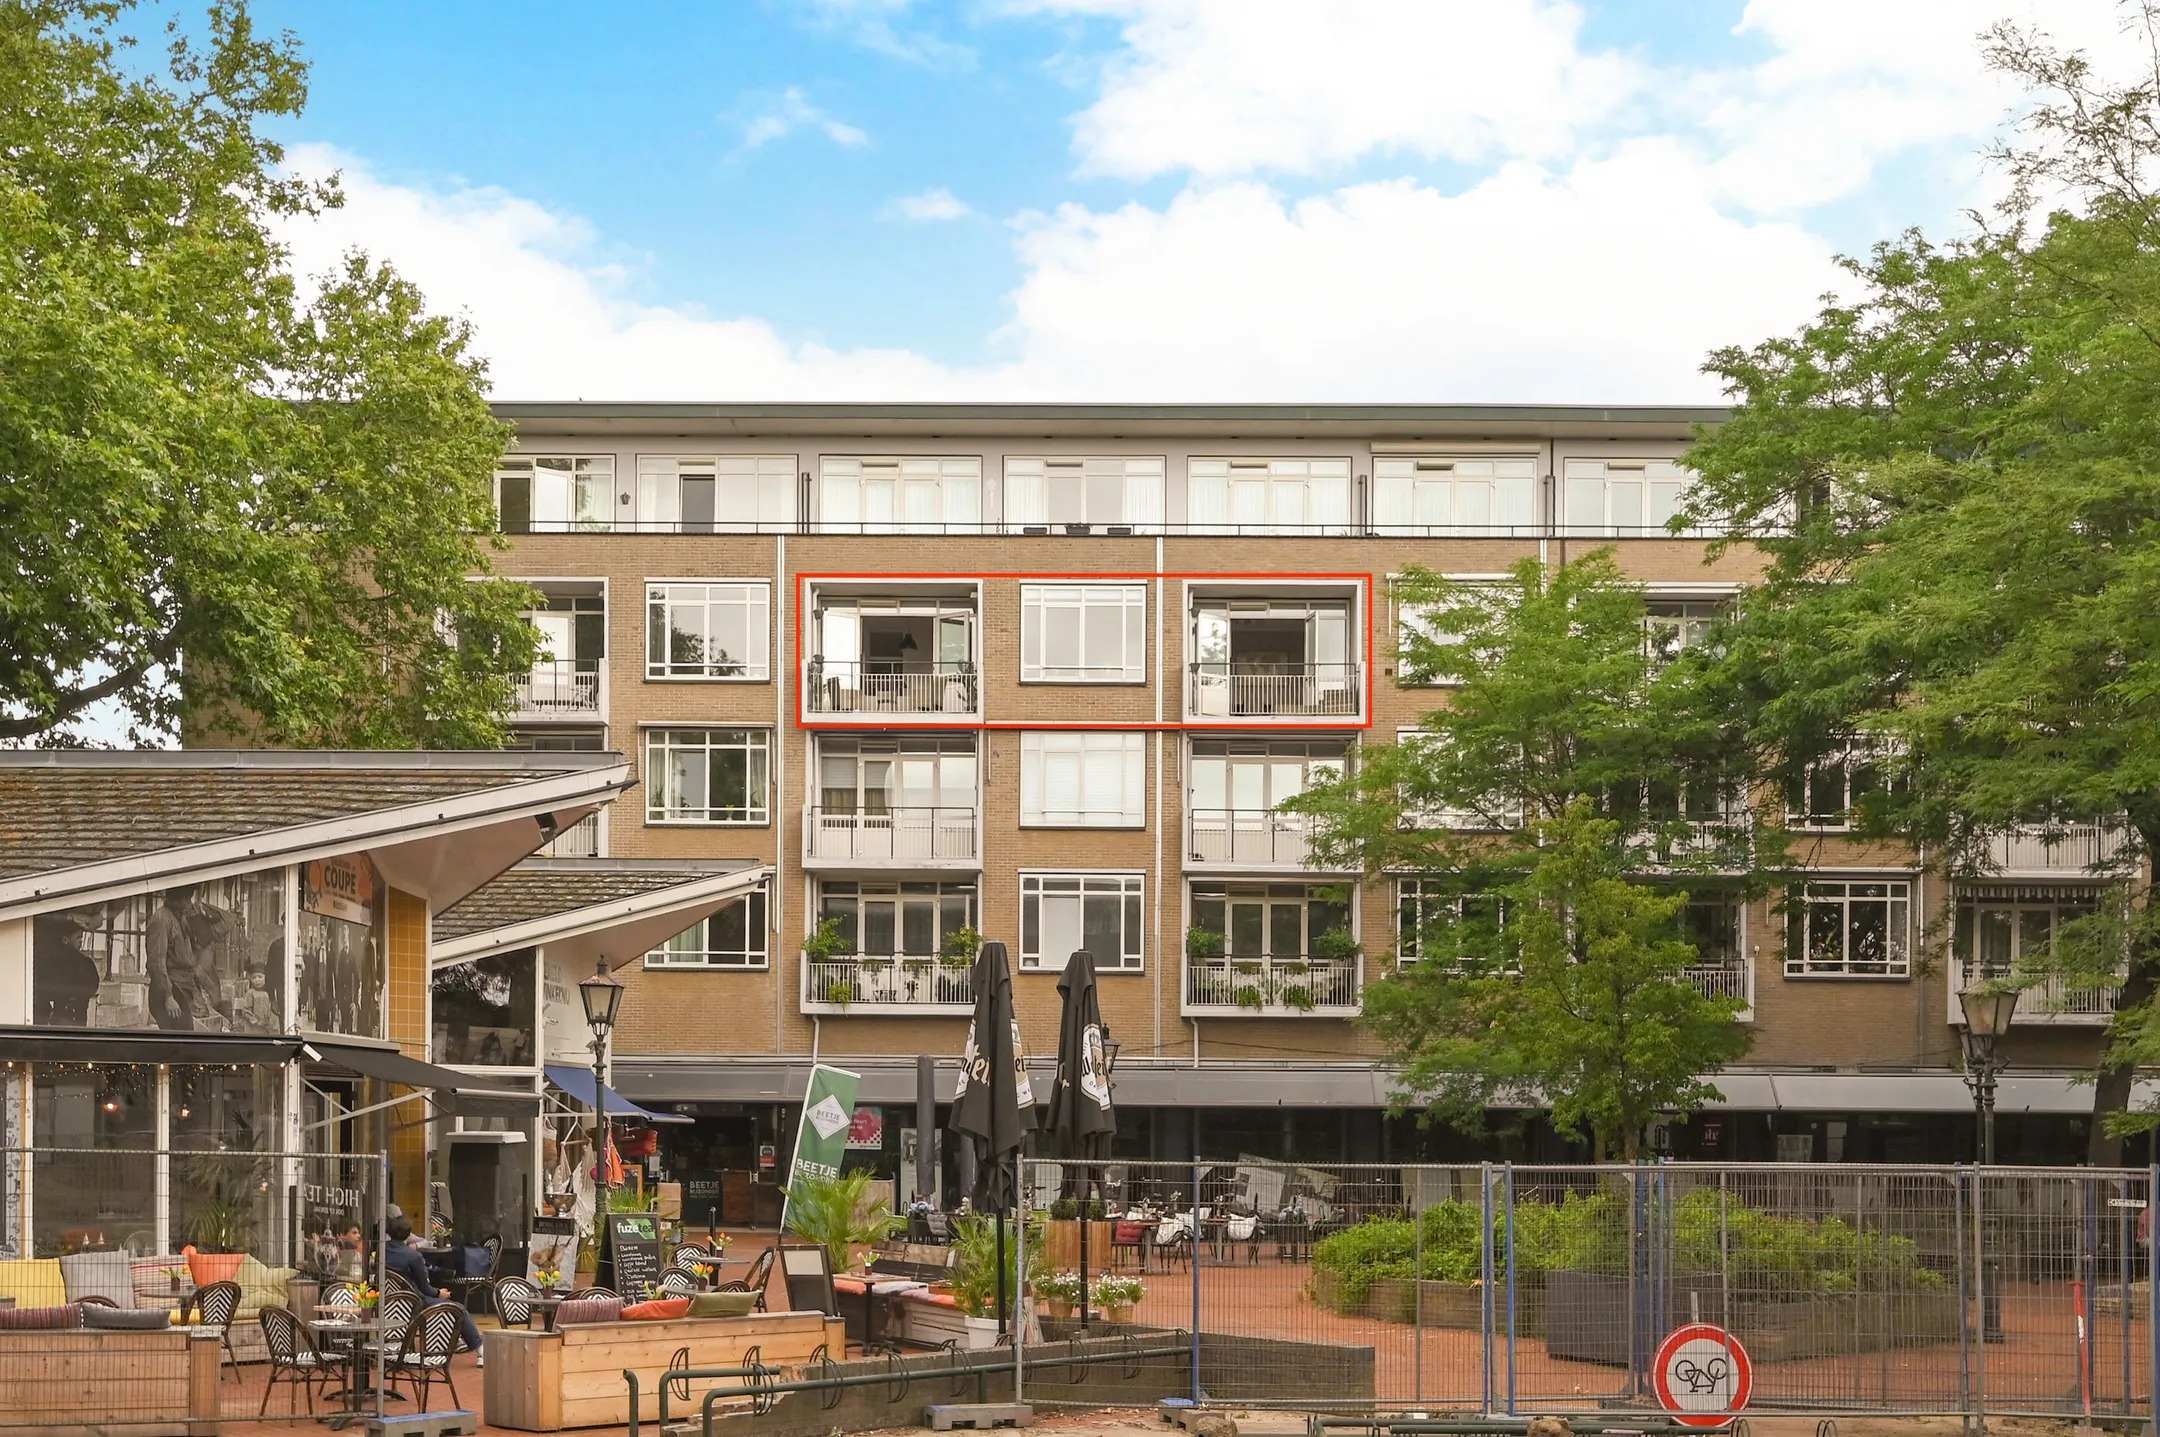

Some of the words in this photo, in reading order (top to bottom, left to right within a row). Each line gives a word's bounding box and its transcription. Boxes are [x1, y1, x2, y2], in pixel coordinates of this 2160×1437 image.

[816, 1109, 841, 1121] BEETJE
[796, 1158, 839, 1178] BEETJE
[689, 1181, 719, 1189] BEETJE
